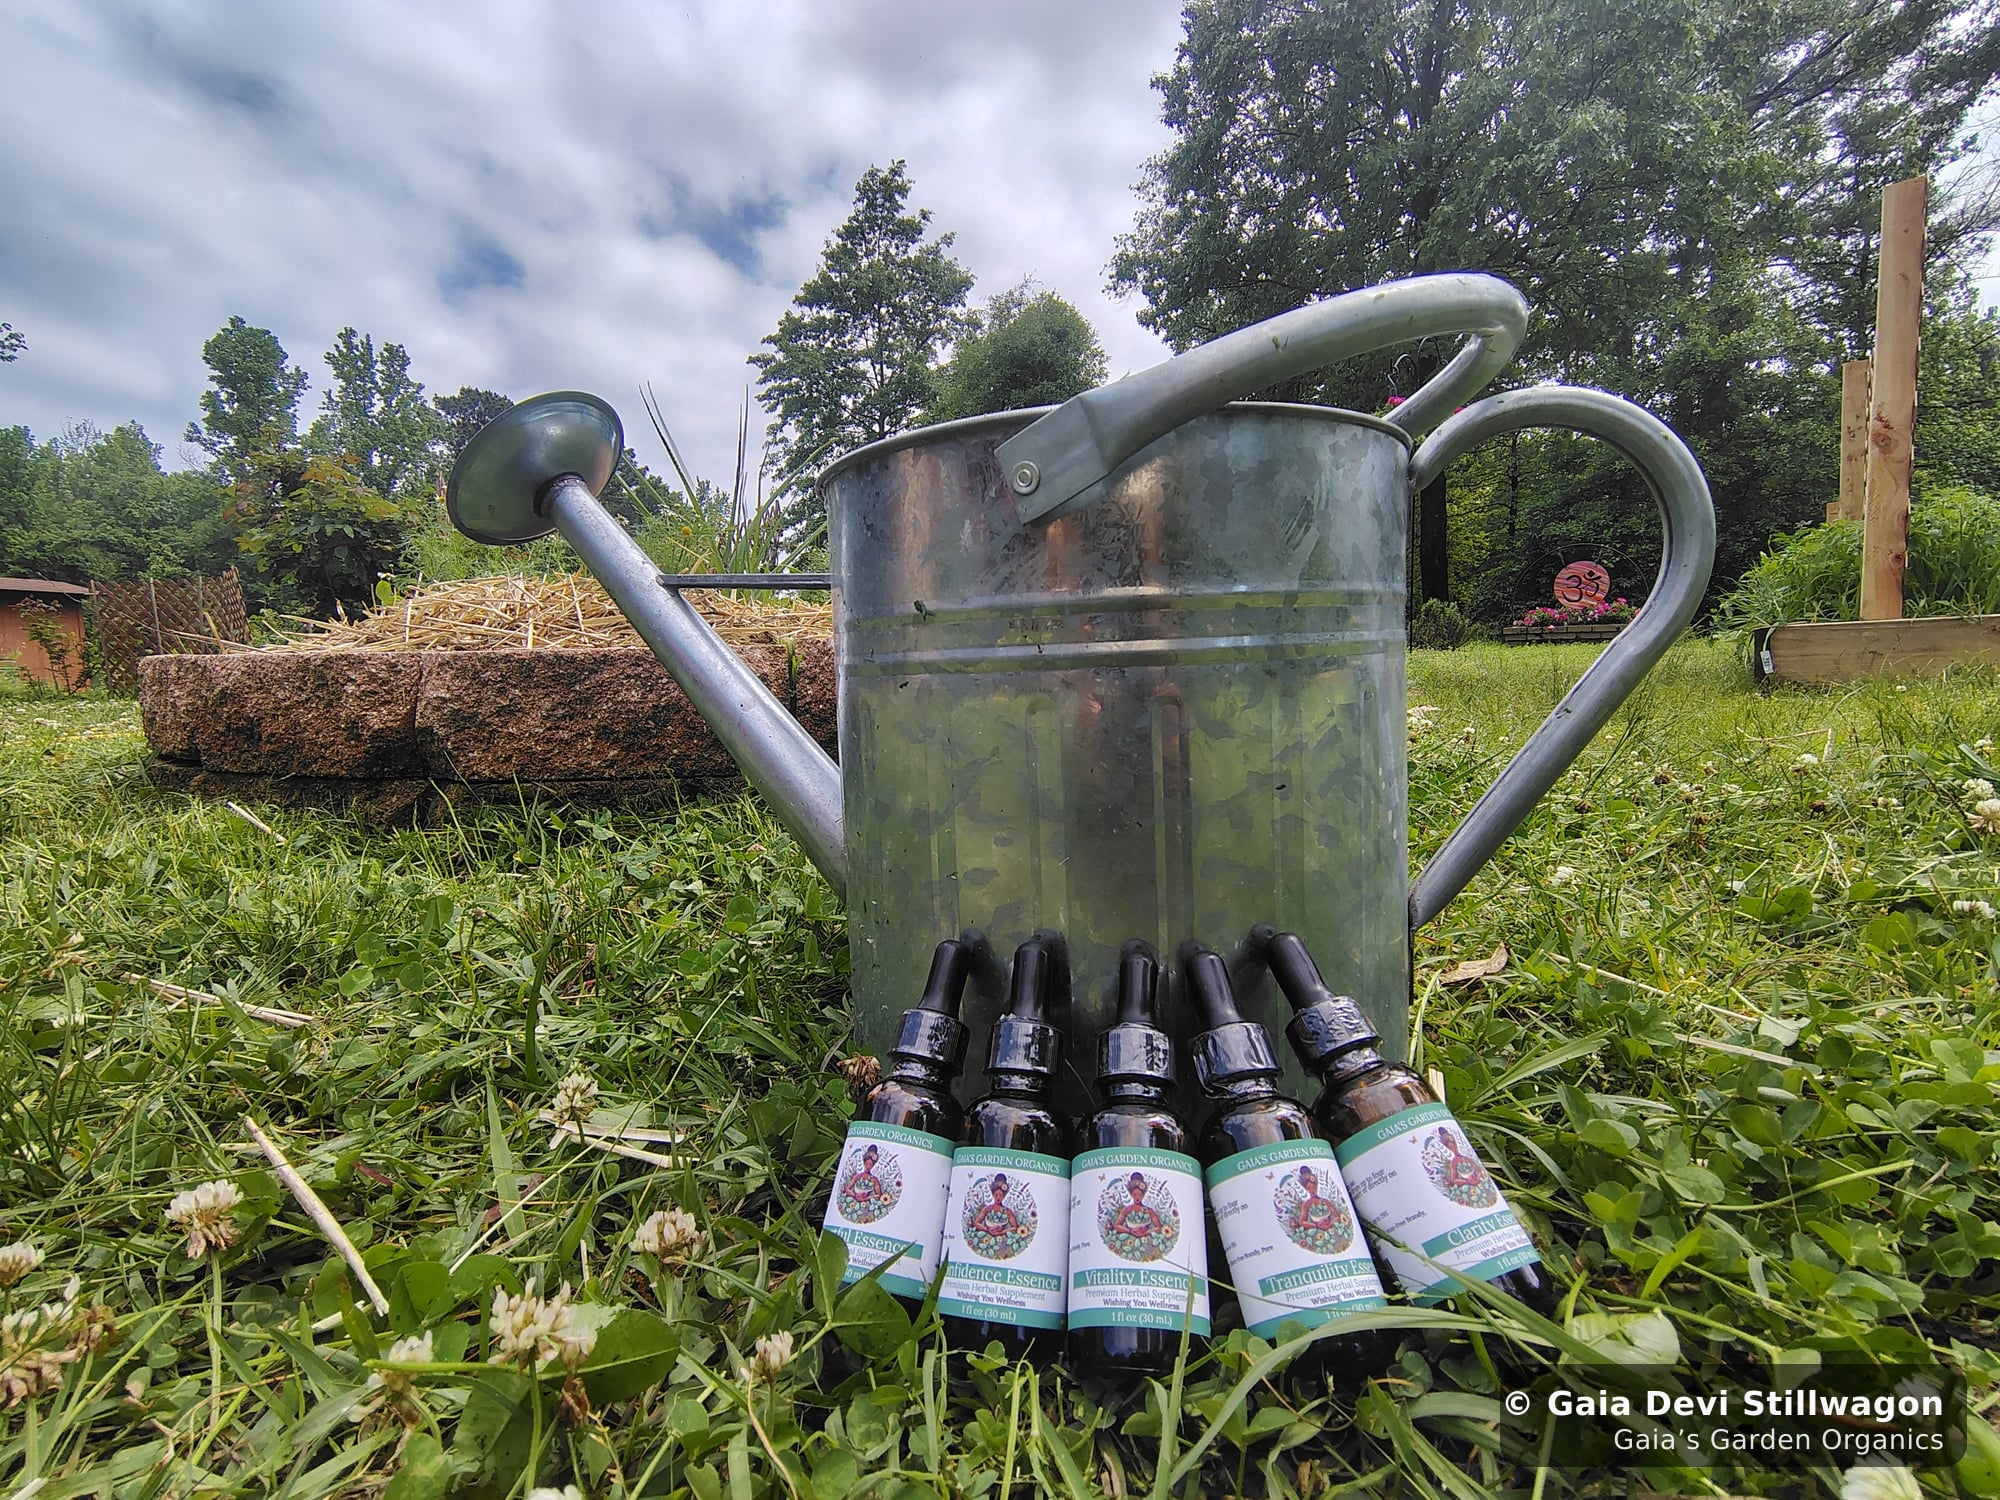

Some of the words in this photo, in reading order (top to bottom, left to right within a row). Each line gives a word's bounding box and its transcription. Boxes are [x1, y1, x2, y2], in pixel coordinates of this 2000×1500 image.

[1377, 1120, 1408, 1140] GAIA'S
[1407, 1110, 1441, 1126] GARDEN
[857, 1126, 886, 1139] GARDEN
[887, 1130, 934, 1149] ORGANICS
[975, 1155, 1013, 1167] GARDEN
[1015, 1158, 1060, 1174] ORGANICS
[1081, 1156, 1105, 1169] GAIA'S
[1106, 1154, 1148, 1165] GARDEN
[1149, 1155, 1193, 1172] ORGANICS
[1237, 1155, 1269, 1171] GAIA'S
[1269, 1147, 1310, 1162] GARDEN
[1447, 1217, 1496, 1246] Clarity
[1454, 1240, 1493, 1259] Premium
[1480, 1244, 1508, 1258] Wishing
[852, 1257, 879, 1268] Wellnes
[946, 1264, 1002, 1282] nfidence
[1006, 1270, 1058, 1290] Essence
[1085, 1268, 1135, 1285] Vitality
[1140, 1270, 1193, 1290] Essenc
[1266, 1262, 1349, 1293] Tranquility
[944, 1280, 970, 1289] Premium
[971, 1283, 998, 1295] Herbal
[1000, 1286, 1046, 1301] Supplement
[956, 1291, 980, 1302] Wishing
[980, 1294, 995, 1303] You
[995, 1296, 1026, 1307] Wellness
[1085, 1289, 1118, 1298] Premium
[1120, 1288, 1150, 1298] Herbal
[1285, 1287, 1326, 1302] Premium
[1326, 1279, 1354, 1294] Herbal
[1310, 1293, 1341, 1305] Wishing
[1341, 1291, 1355, 1300] You
[966, 1305, 973, 1315] fl
[974, 1308, 983, 1317] oz
[984, 1308, 999, 1320] (30
[1102, 1299, 1131, 1308] Wishing
[1132, 1299, 1147, 1307] You
[1148, 1300, 1180, 1310] Wellness
[1117, 1312, 1124, 1321] fl
[1126, 1314, 1137, 1322] oz
[1138, 1313, 1154, 1325] (30
